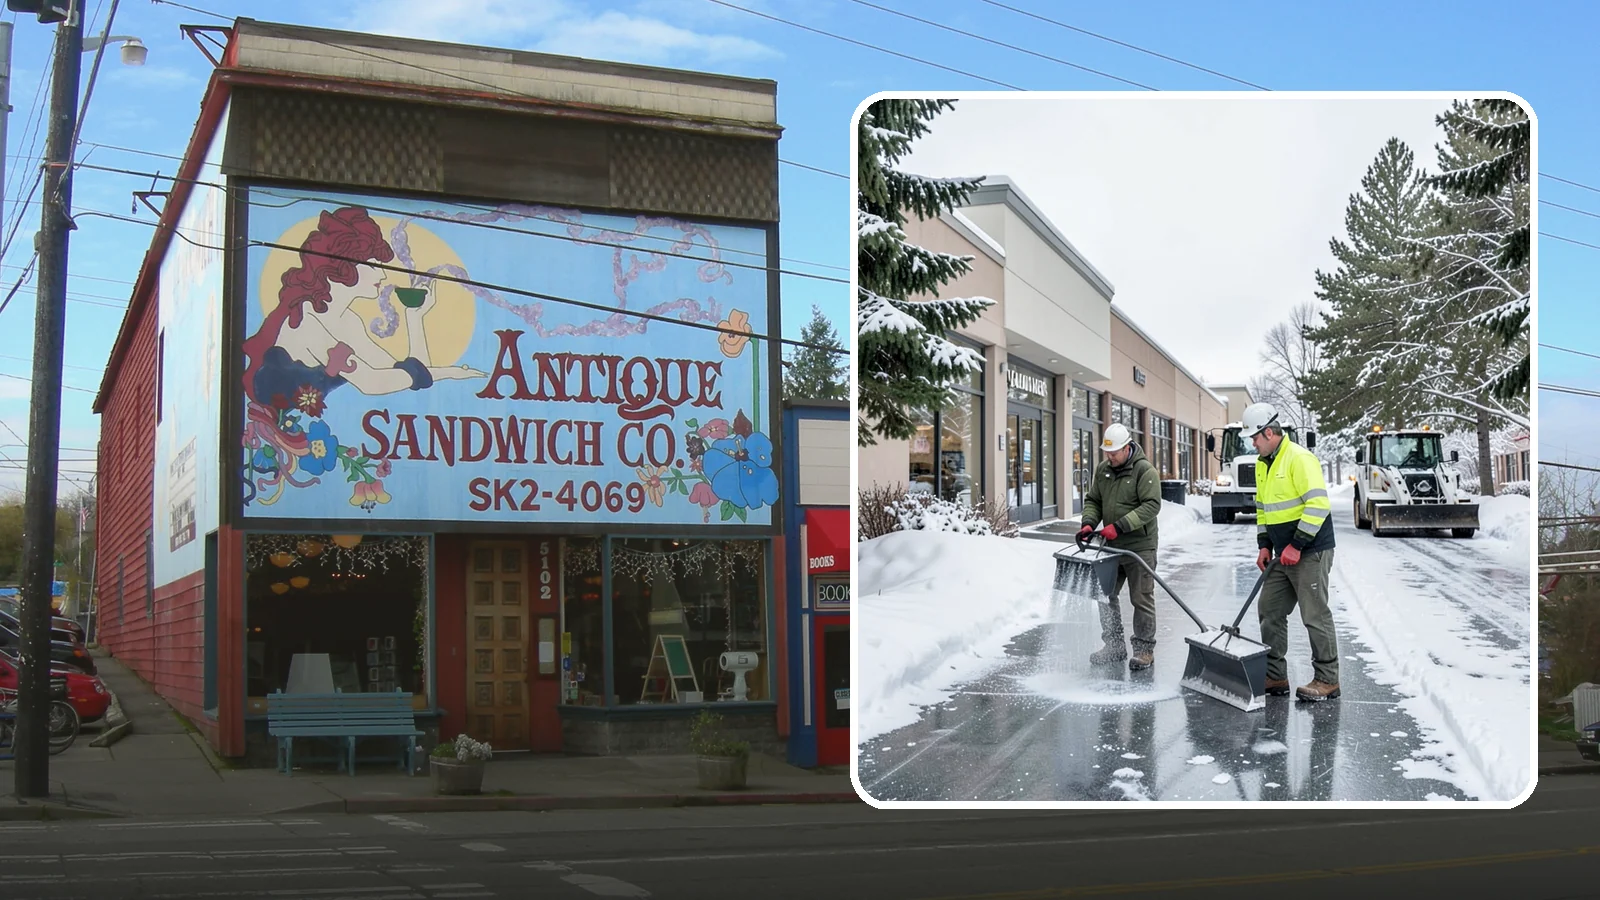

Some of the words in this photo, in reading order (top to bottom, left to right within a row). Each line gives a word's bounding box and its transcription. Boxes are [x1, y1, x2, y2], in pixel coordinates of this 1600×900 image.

[475, 330, 724, 421] ANTIQUE
[361, 408, 604, 467] SANDWICH
[617, 421, 685, 468] CO.
[468, 477, 645, 513] SK2-4069
[540, 541, 551, 600] 5102
[809, 555, 834, 569] BOOKS
